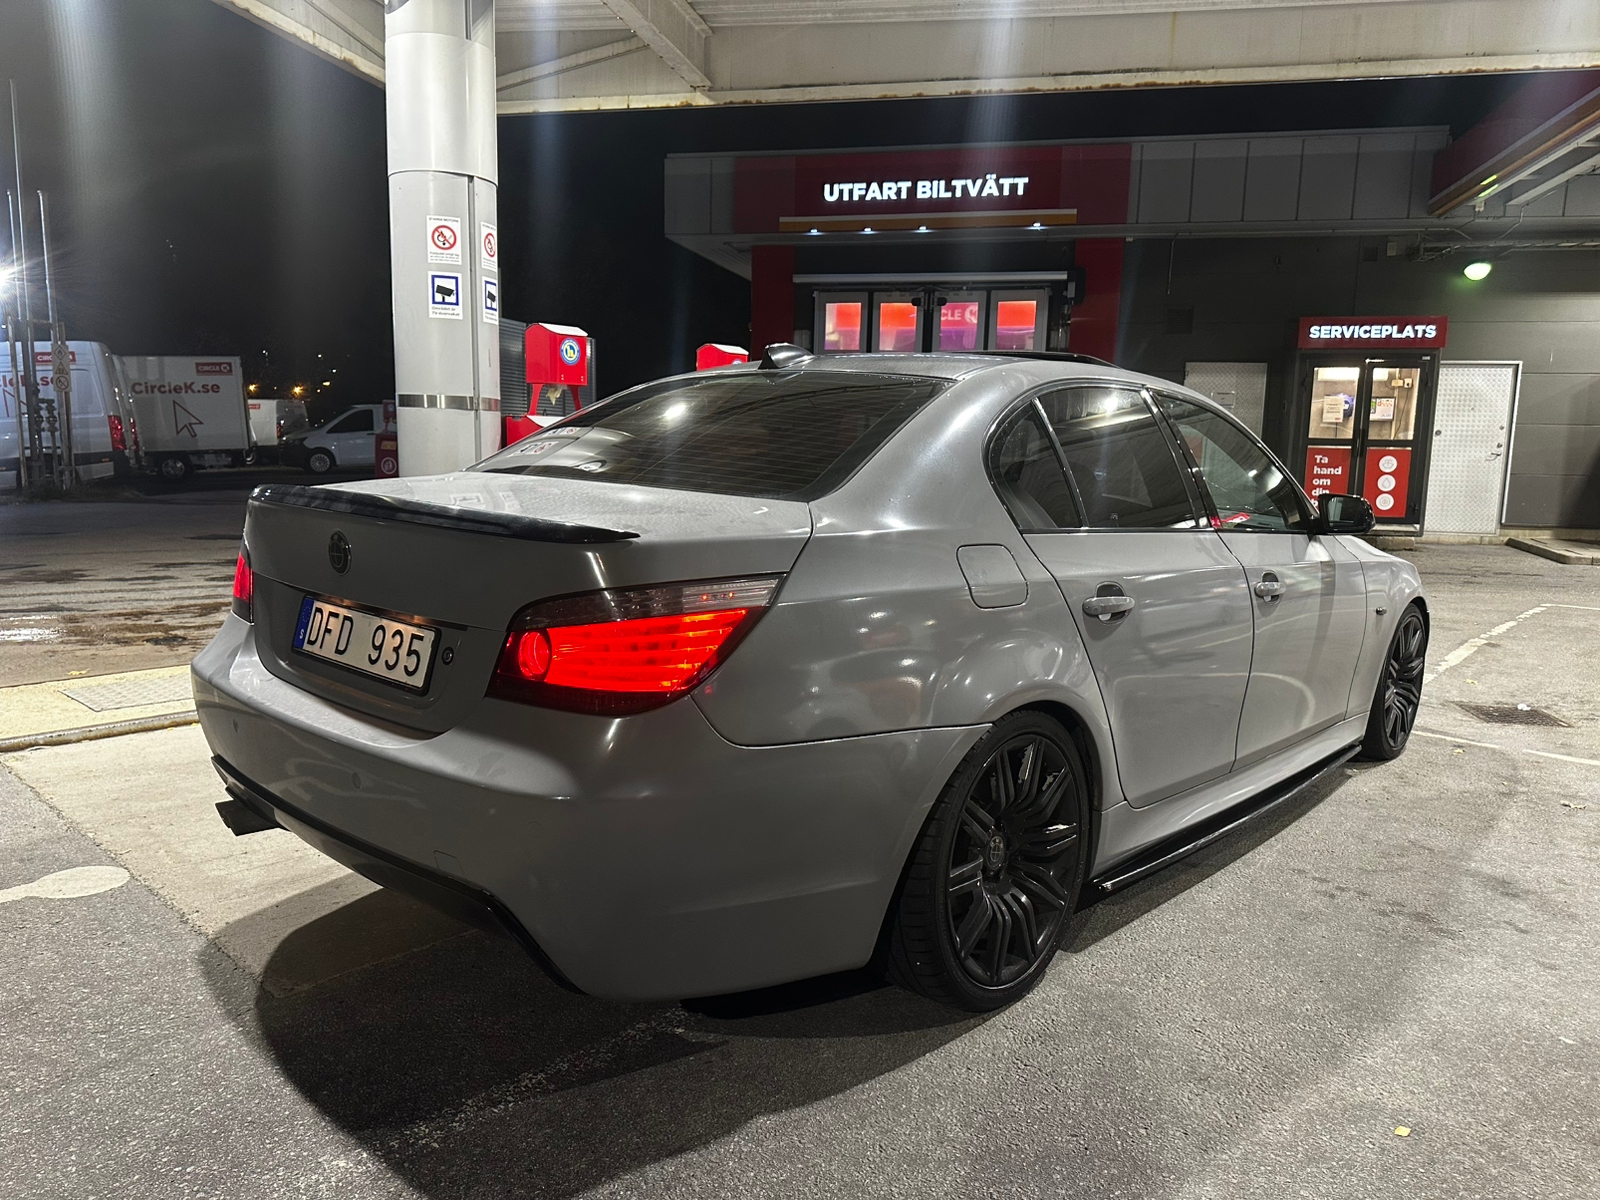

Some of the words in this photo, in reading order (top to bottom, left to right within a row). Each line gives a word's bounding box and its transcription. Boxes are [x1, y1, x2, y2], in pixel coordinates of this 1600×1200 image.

[824, 181, 912, 201] UTFART
[917, 174, 1029, 199] BILTVÄTT
[1309, 325, 1437, 339] SERVICEPLATS
[131, 382, 221, 395] CircleK.se
[1314, 454, 1329, 464] Ta
[1313, 465, 1342, 475] hand
[1312, 478, 1331, 486] om
[299, 628, 305, 640] S
[306, 607, 354, 656] DFD
[368, 624, 425, 677] 935
